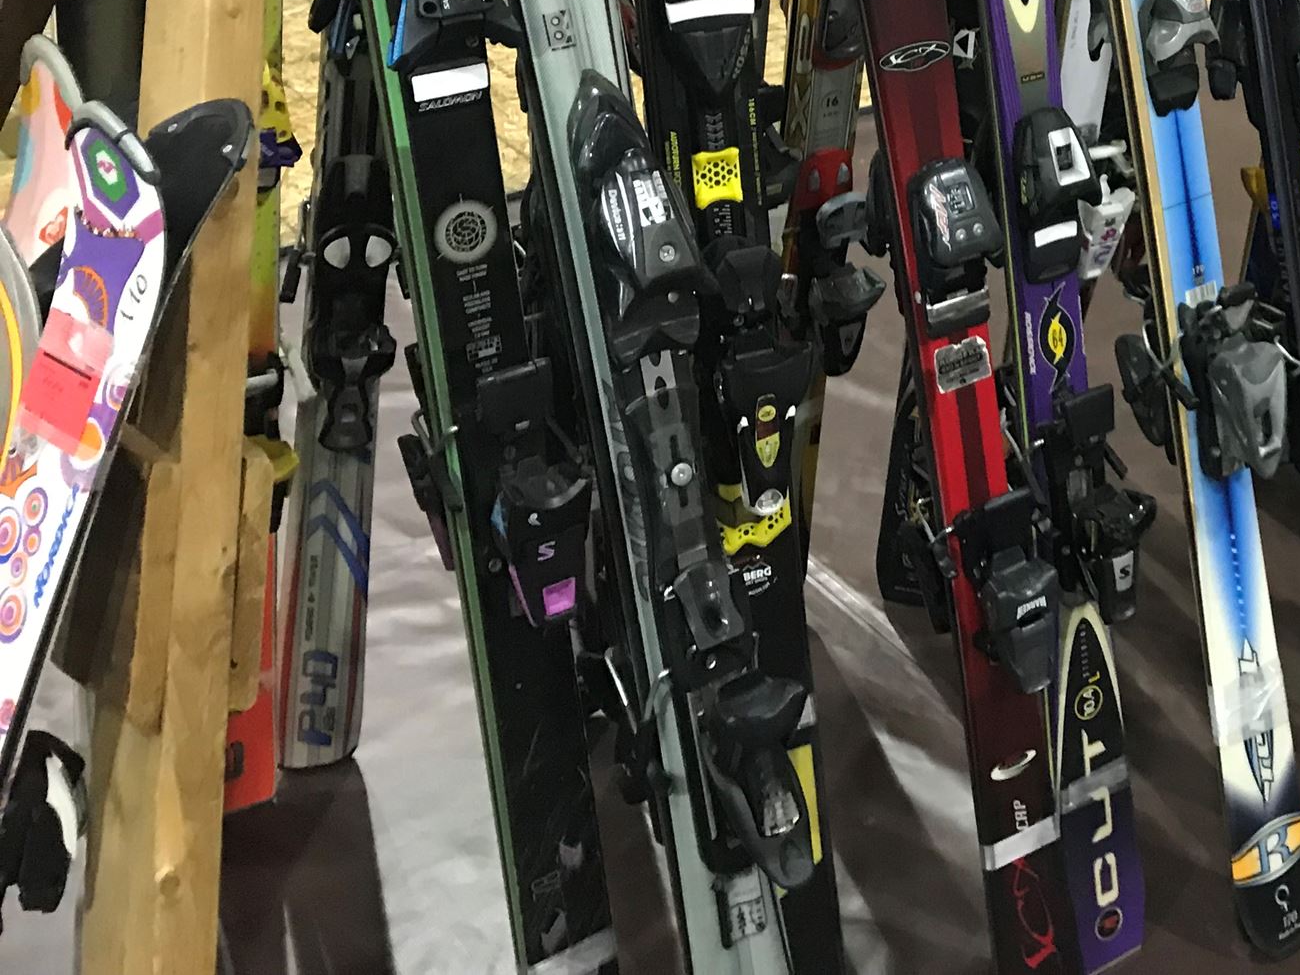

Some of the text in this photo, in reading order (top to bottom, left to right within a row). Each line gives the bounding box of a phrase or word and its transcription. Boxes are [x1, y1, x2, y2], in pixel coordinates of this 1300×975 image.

[418, 91, 483, 113] SALOMON
[1013, 799, 1029, 831] CAP
[1080, 728, 1121, 907] CUT
